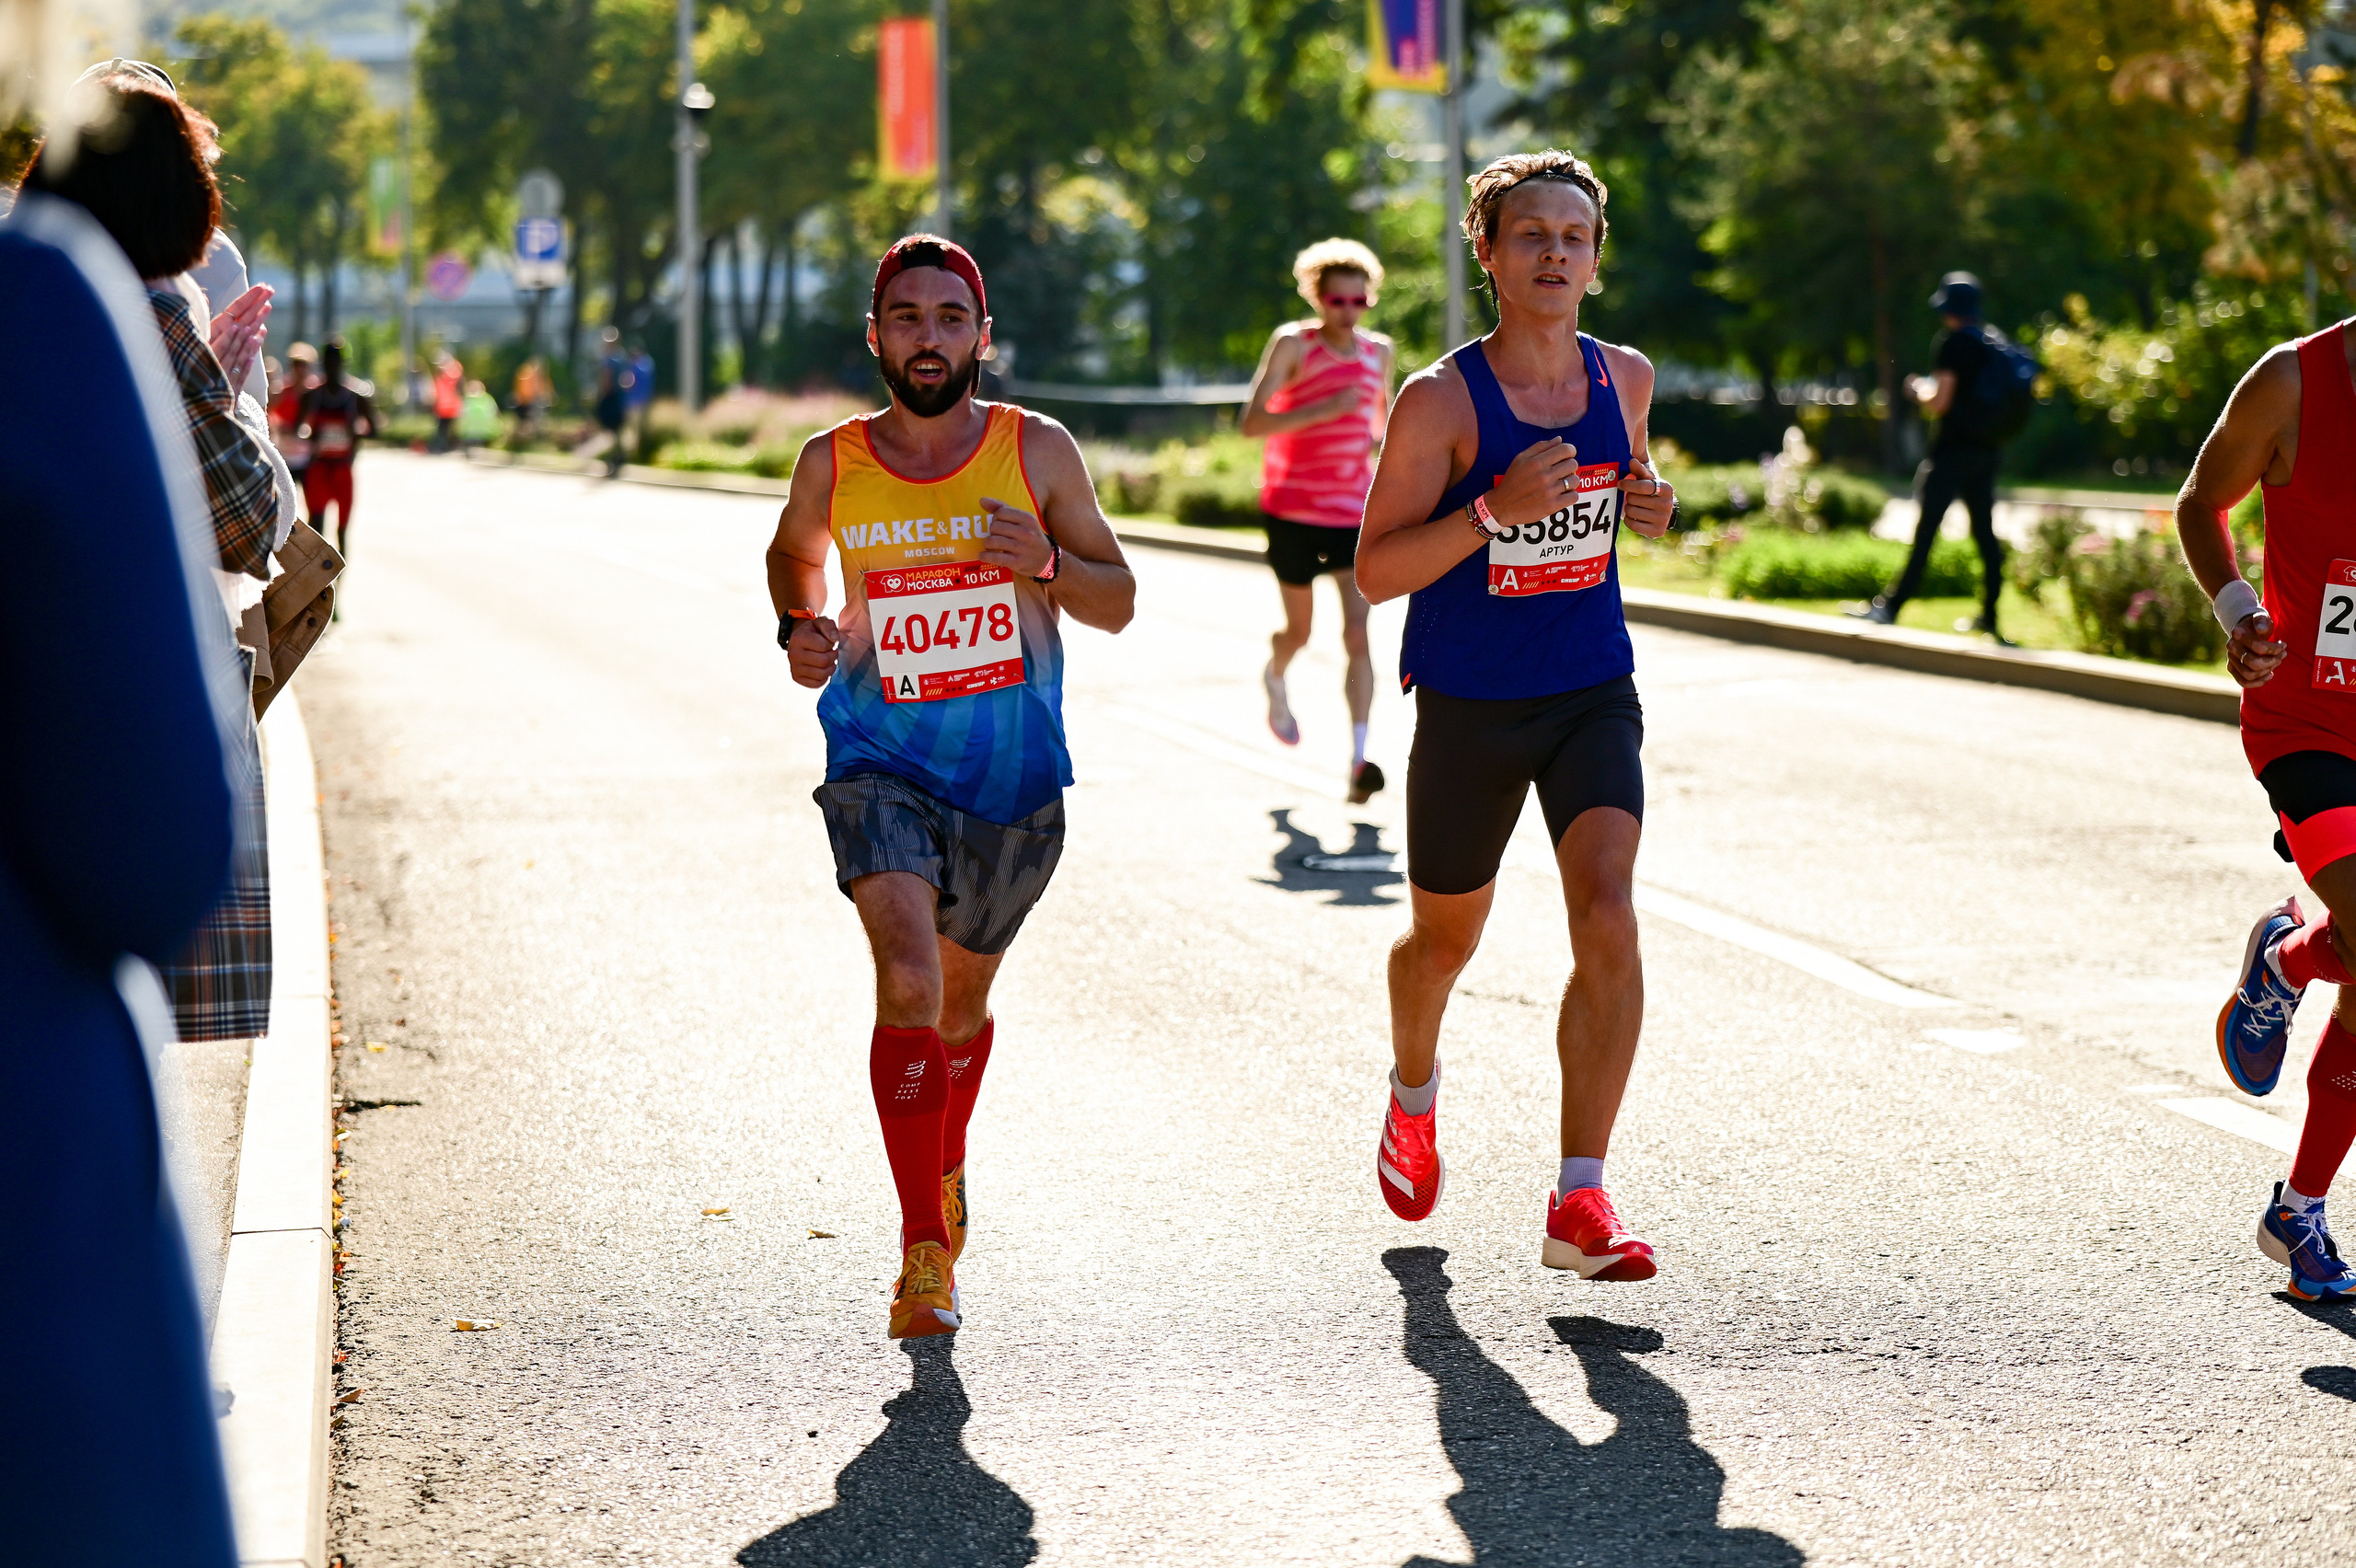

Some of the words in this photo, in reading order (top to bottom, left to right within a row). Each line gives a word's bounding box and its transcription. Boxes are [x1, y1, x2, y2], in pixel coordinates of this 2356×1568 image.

[1579, 478, 1591, 489] 10
[905, 547, 955, 558] MOSCOW
[906, 567, 961, 582] МАРАФОН
[964, 574, 977, 584] 10
[907, 579, 953, 592] МОСКВА
[2325, 595, 2356, 635] 2
[881, 603, 1014, 655] 40478
